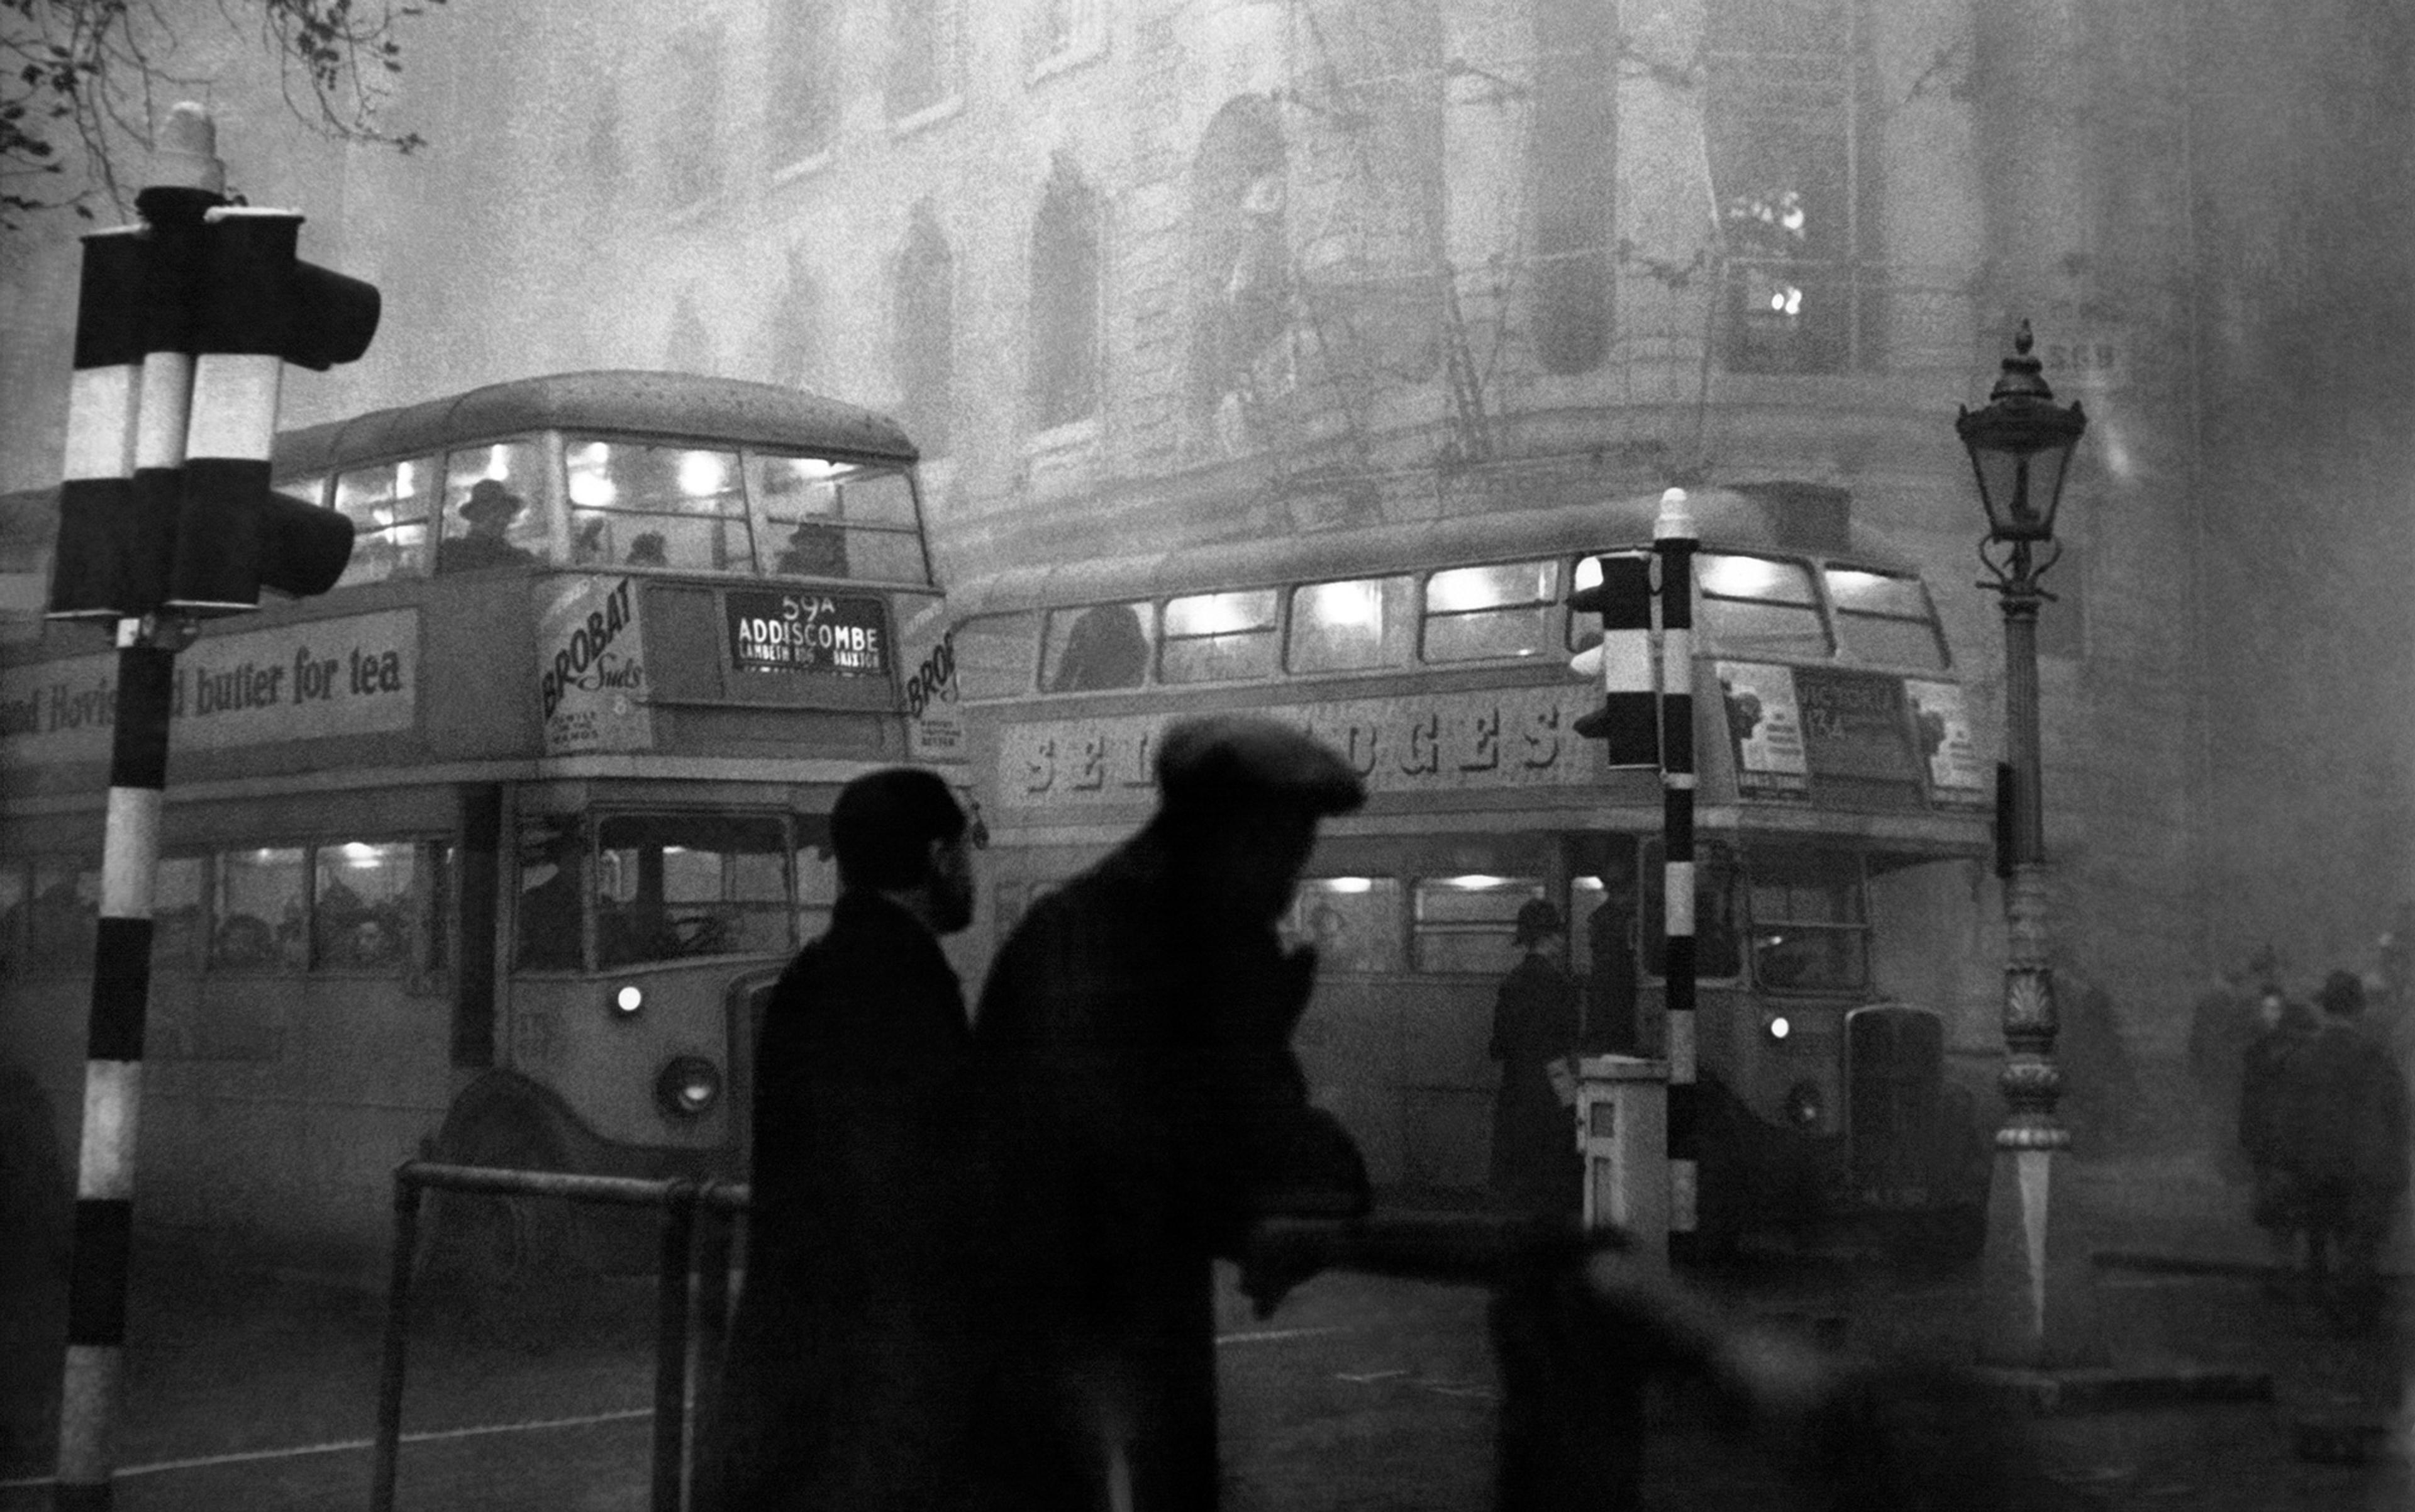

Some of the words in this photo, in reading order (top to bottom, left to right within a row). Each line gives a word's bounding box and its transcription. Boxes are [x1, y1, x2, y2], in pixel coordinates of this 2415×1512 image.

[782, 596, 836, 622] 59A
[541, 574, 631, 723] BROBAT
[738, 617, 879, 653] ADDISCOMBE
[739, 642, 790, 660] LAMBETH
[833, 650, 880, 668] BRIXTON
[195, 662, 285, 717] butter
[291, 645, 339, 705] for
[350, 645, 402, 695] tea
[577, 652, 643, 692] Suds
[1025, 704, 1559, 792] SELDGES
